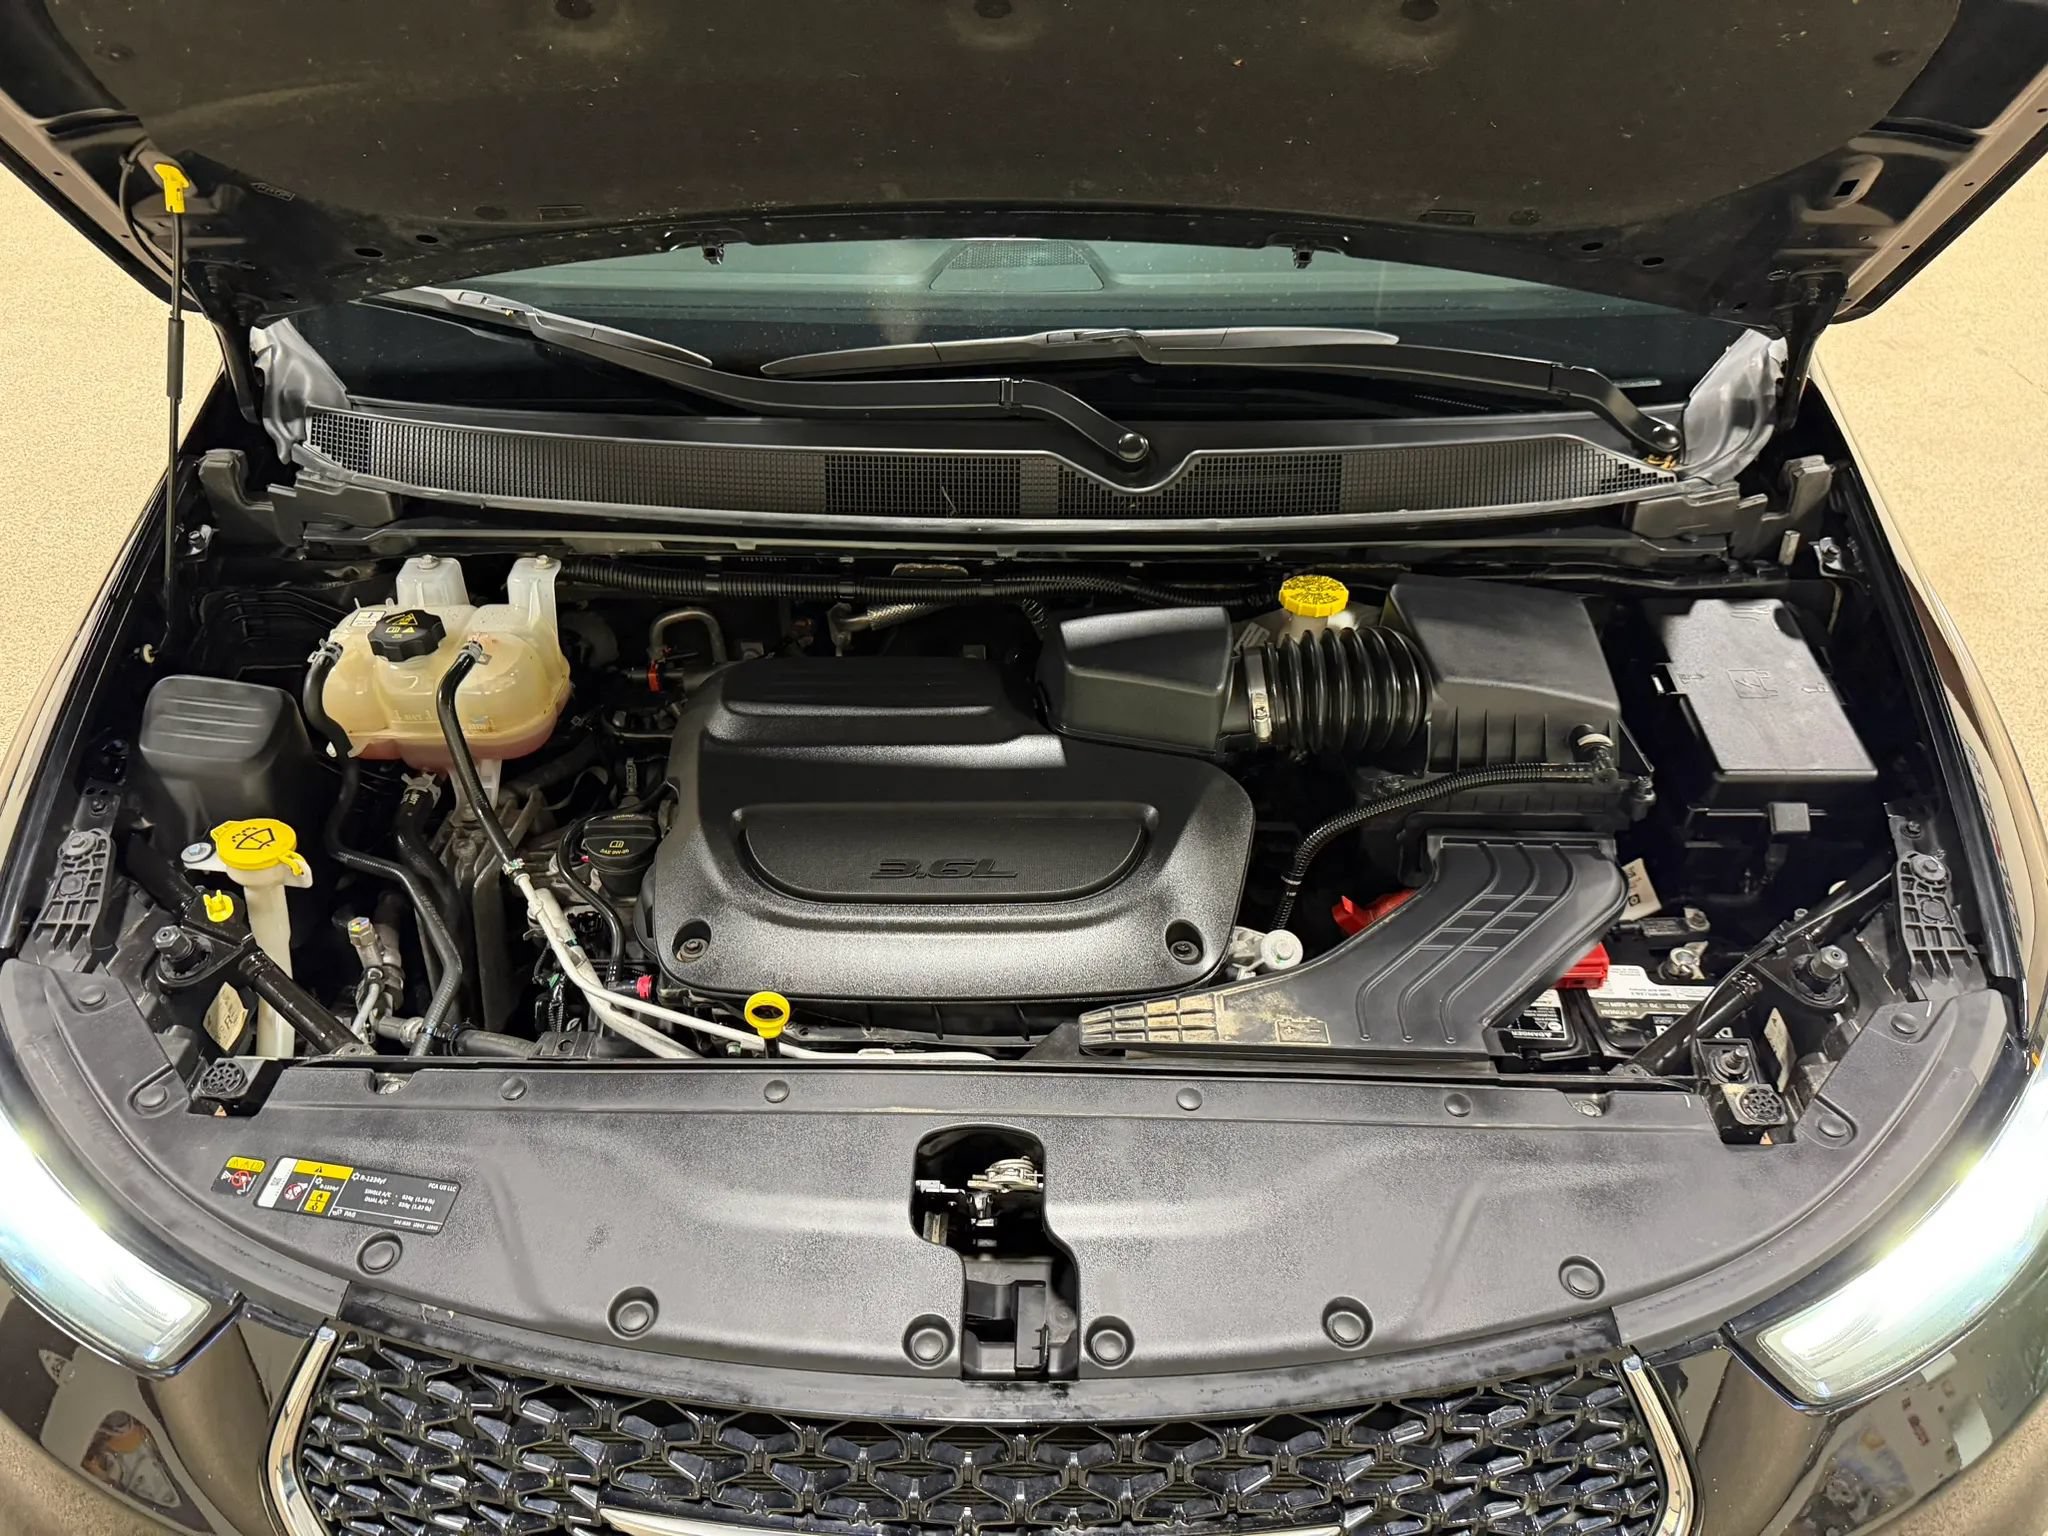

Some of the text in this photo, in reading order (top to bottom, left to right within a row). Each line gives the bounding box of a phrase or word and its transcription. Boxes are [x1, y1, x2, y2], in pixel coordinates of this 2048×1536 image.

[870, 858, 1018, 879] 3.6L
[1511, 1030, 1545, 1038] DANGER
[360, 1175, 387, 1184] R-1234yf
[428, 1182, 439, 1190] FCA
